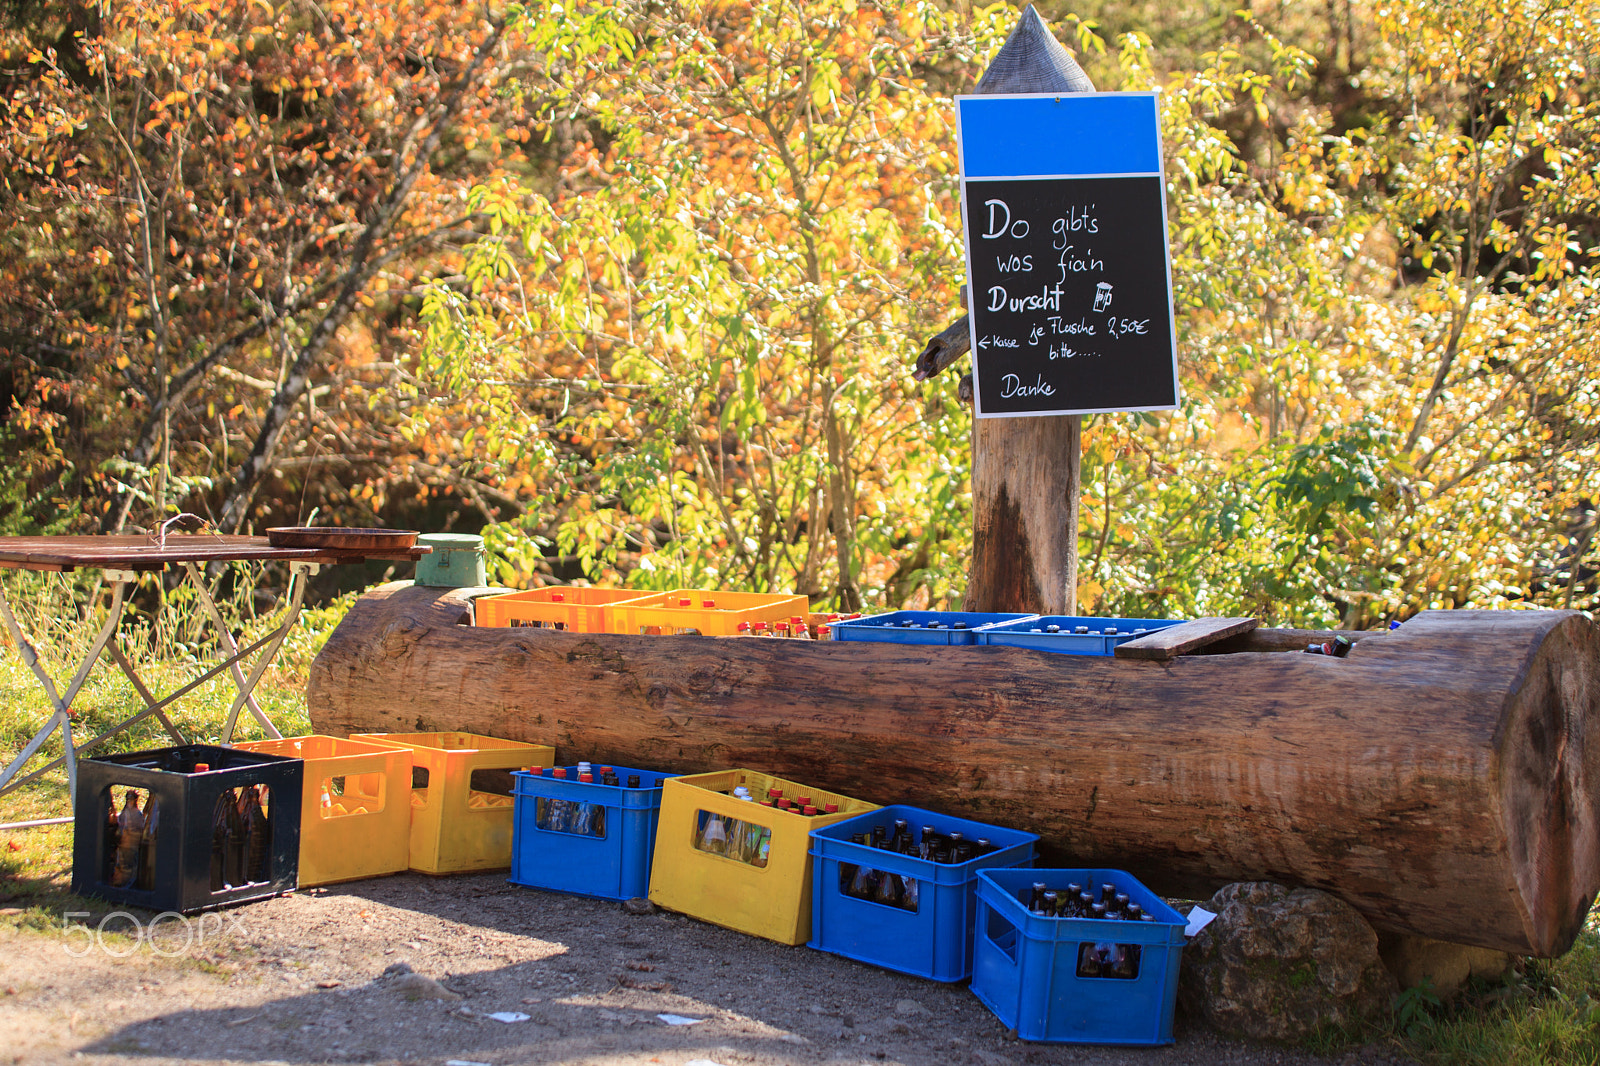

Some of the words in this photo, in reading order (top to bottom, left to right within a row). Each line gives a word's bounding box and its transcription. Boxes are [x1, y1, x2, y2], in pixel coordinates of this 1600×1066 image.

[982, 199, 1030, 239] Do
[1052, 203, 1099, 249] gibt's
[987, 284, 1065, 313] Durscht
[993, 335, 1020, 348] Kasse
[1028, 323, 1046, 346] je
[1047, 315, 1097, 336] Flasche
[1107, 316, 1150, 340] 2,50€
[1000, 373, 1057, 399] Danke
